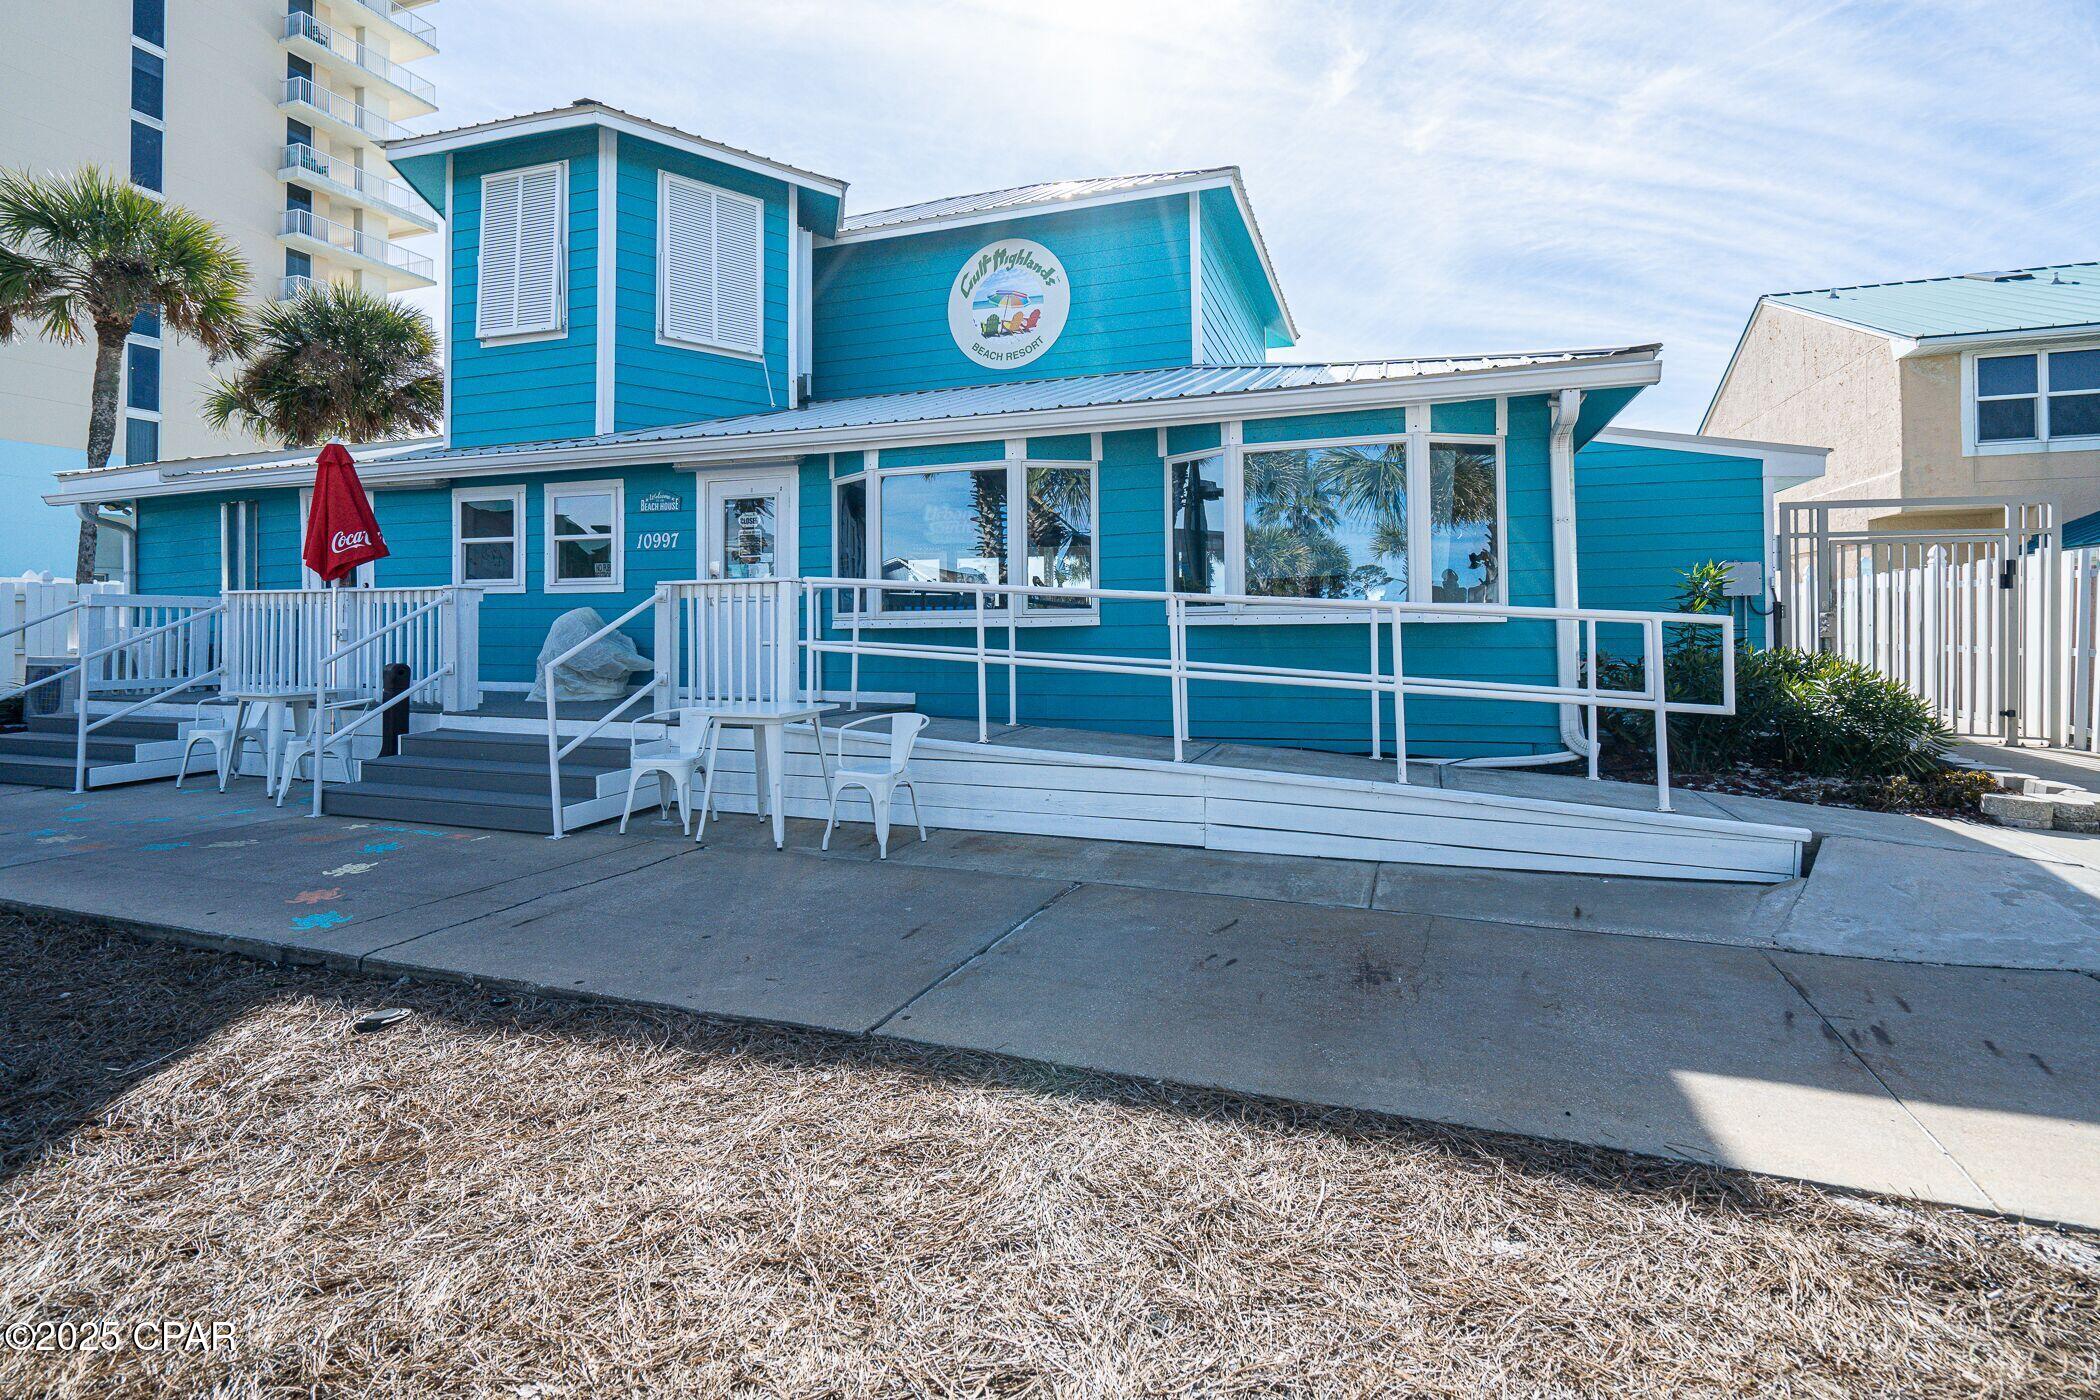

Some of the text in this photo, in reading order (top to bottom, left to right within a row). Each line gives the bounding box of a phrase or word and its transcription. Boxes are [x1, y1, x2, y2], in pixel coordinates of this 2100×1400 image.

[960, 248, 1056, 299] Gulf Highlands
[971, 335, 1044, 361] BEACH RESORT
[640, 497, 679, 512] BEACH HOUSE
[636, 532, 680, 550] 10997
